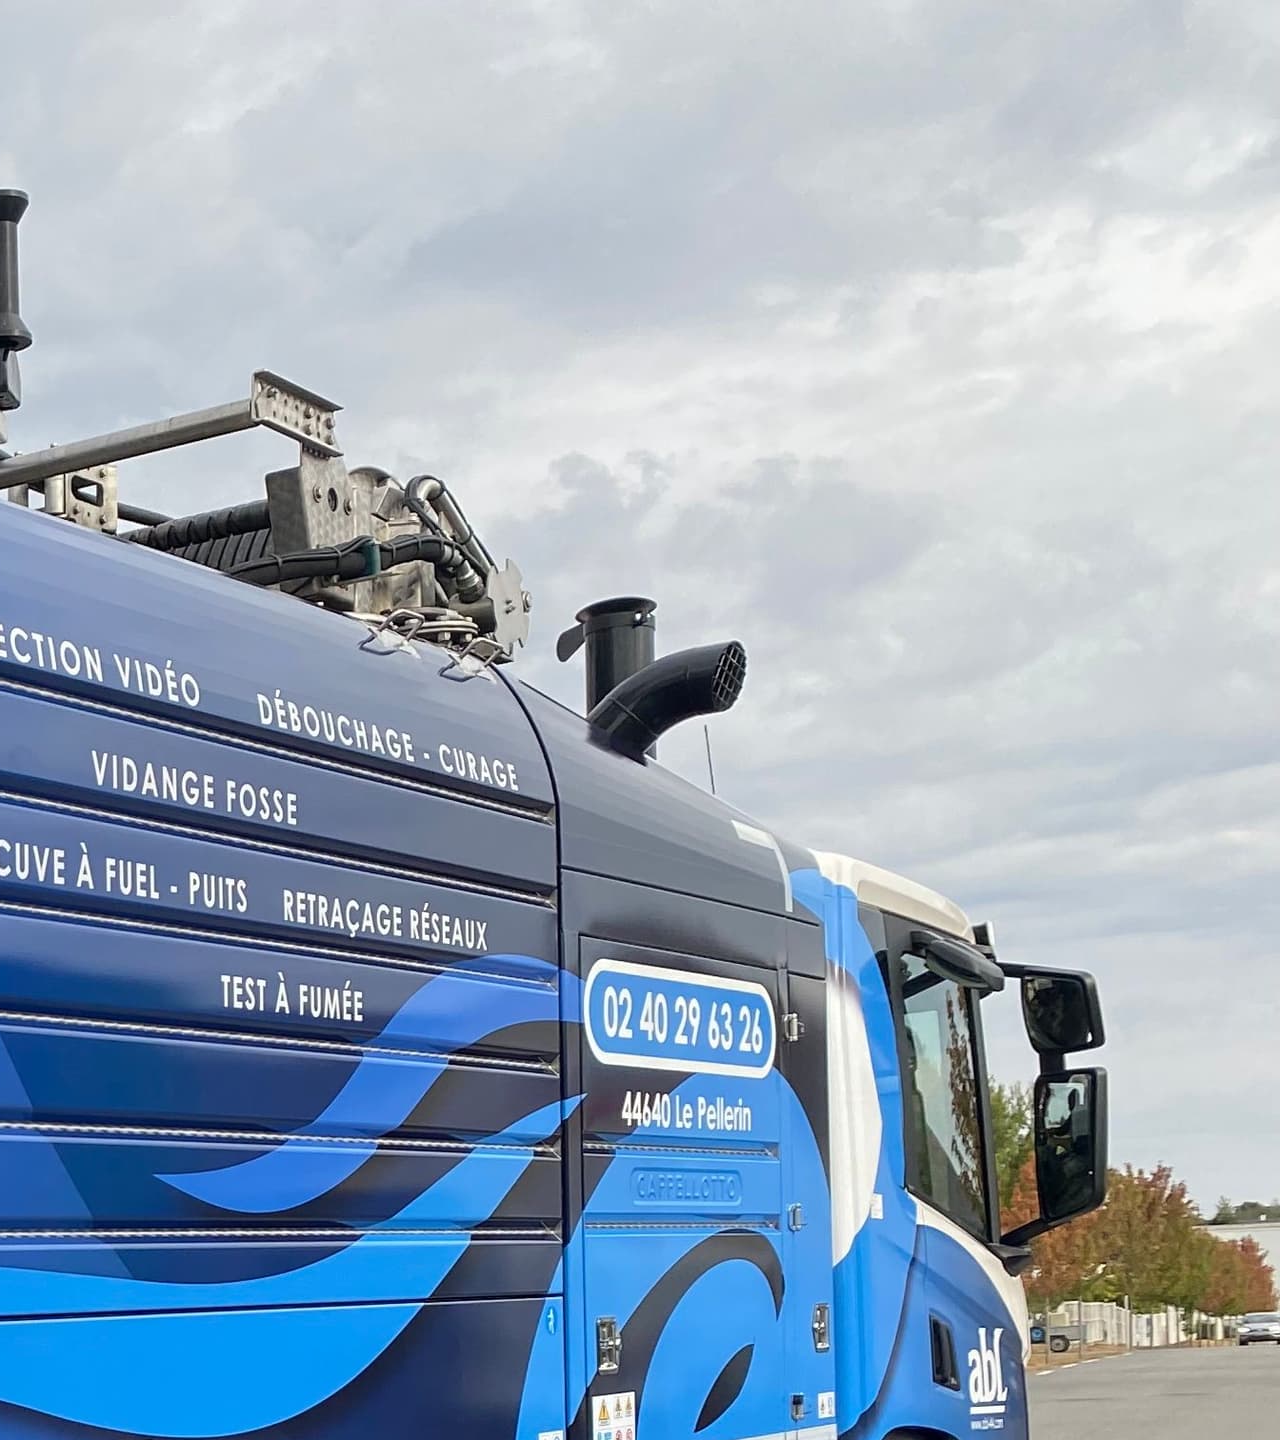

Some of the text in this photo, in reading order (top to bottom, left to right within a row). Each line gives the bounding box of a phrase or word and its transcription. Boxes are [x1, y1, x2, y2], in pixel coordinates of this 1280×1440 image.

[113, 649, 201, 707] VIDÉO
[256, 688, 415, 763] DÉBOUCHAGE
[438, 743, 520, 792] CURAGE
[91, 749, 298, 826] VIDANGE FOSSE
[75, 841, 95, 890] À
[105, 856, 161, 900] FUEL
[188, 871, 249, 913] PUITS
[282, 888, 489, 952] RETRAÇAGE RÉSEAUX
[220, 970, 365, 1023] TEST À FUMÉE
[603, 985, 764, 1056] 02 40 29 63 26
[621, 1089, 753, 1132] 44640 Le Pellerin
[636, 1171, 737, 1200] CAPPELLOTTO
[967, 1327, 1009, 1404] abl
